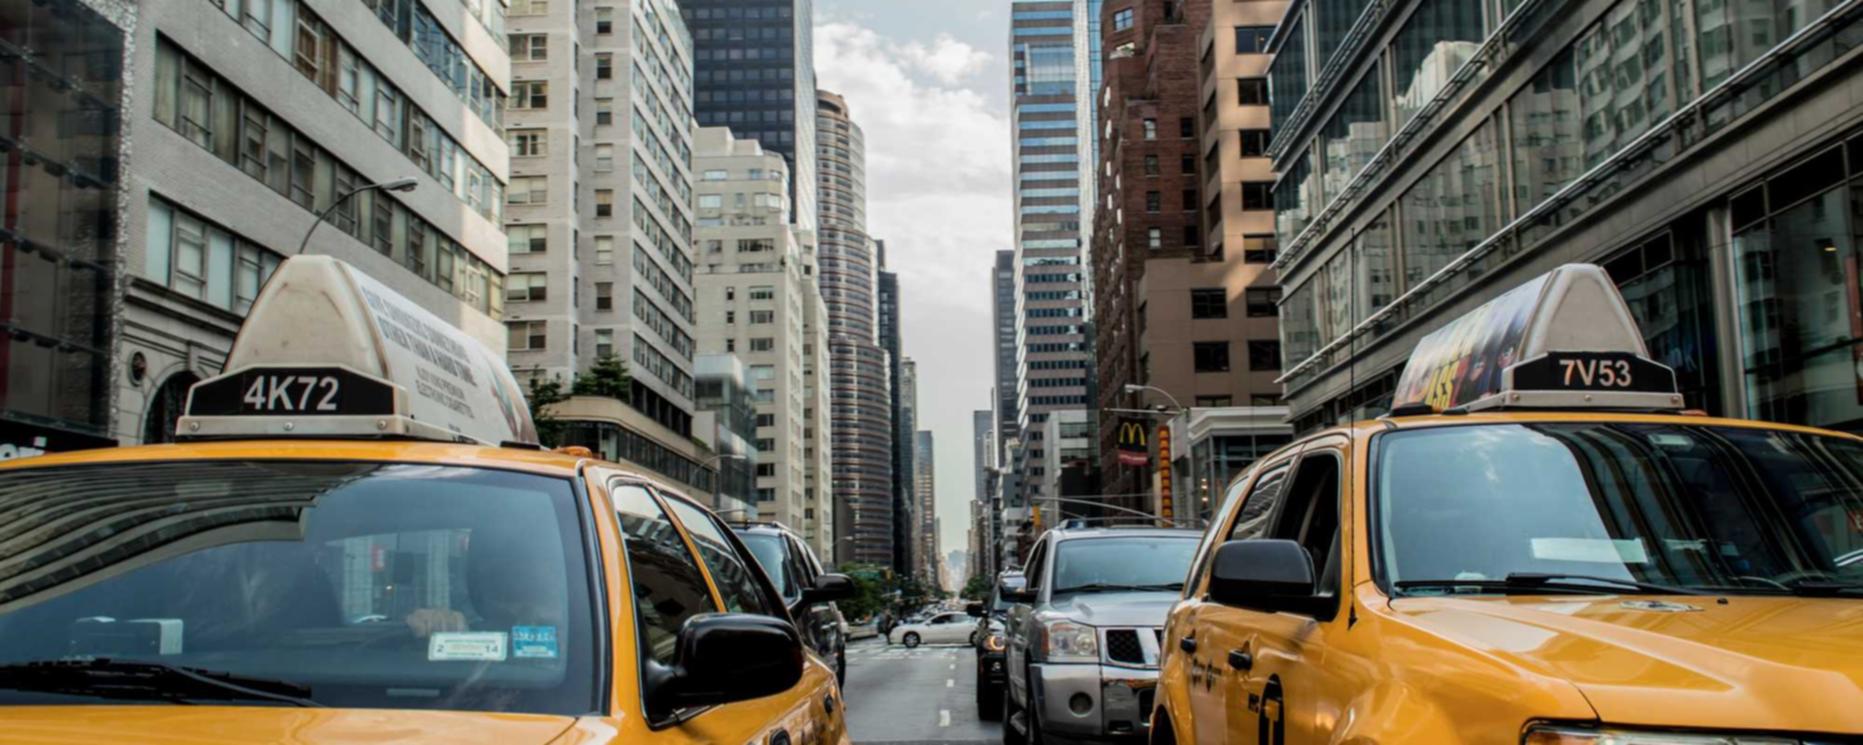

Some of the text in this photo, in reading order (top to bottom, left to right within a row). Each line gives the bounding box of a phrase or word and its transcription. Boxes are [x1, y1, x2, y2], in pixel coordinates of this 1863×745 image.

[1558, 359, 1632, 387] 7V53
[243, 375, 339, 411] 4K72
[485, 644, 499, 654] 14
